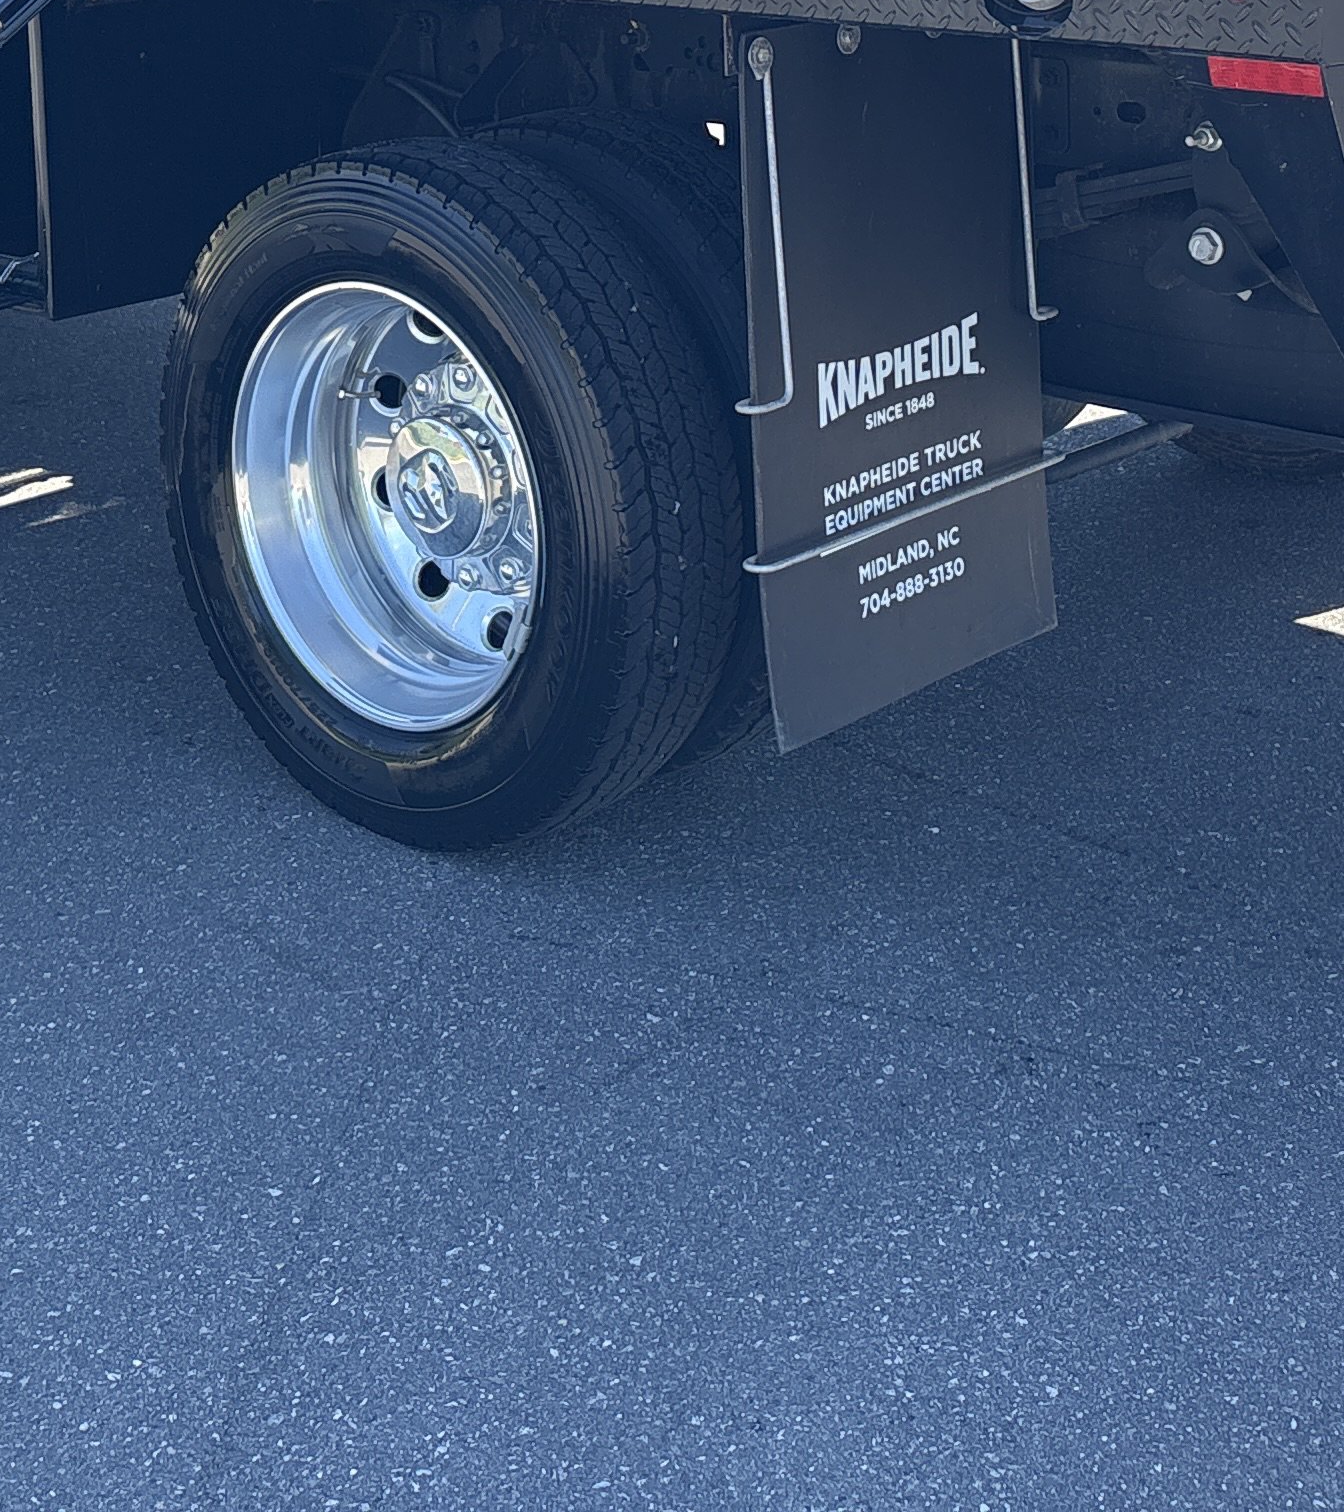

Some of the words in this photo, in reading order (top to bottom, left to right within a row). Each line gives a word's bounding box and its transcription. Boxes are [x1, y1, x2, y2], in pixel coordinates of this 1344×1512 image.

[865, 402, 904, 431] SINCE
[905, 391, 935, 416] 1848
[823, 451, 921, 507] KNAPHEIDE
[923, 429, 982, 467] TRUCK
[824, 481, 917, 536] EQUIPMENT
[920, 457, 984, 496] CENTER
[858, 538, 935, 585] MIDLAND,
[937, 525, 961, 552] NC
[859, 556, 965, 619] 704-888-3130
